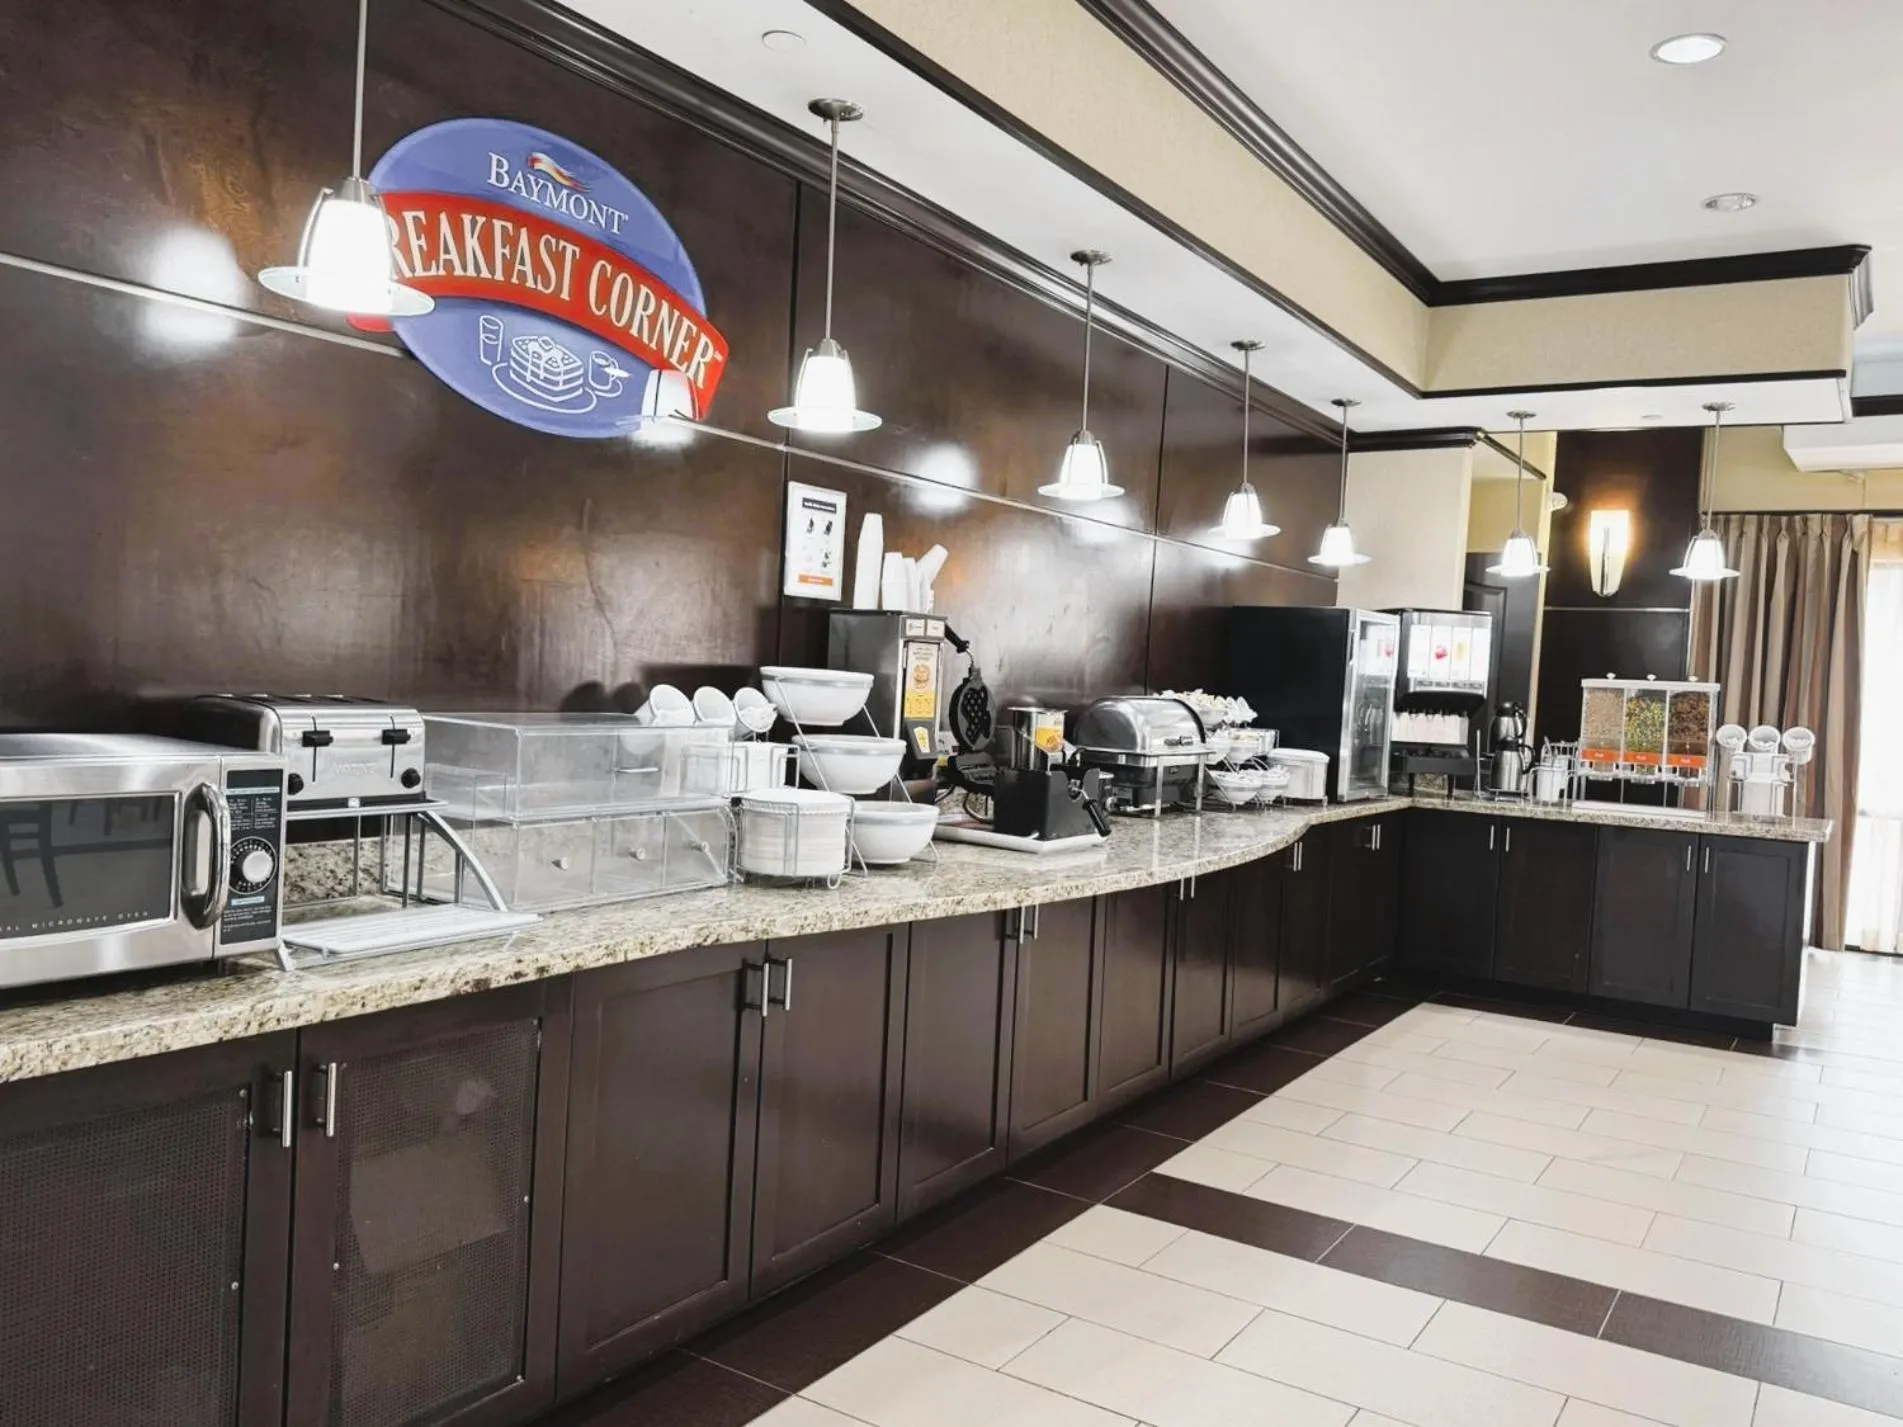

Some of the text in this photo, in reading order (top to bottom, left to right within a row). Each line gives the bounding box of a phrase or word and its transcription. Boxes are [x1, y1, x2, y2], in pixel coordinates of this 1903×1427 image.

[487, 151, 626, 235] BAYMONT
[385, 210, 714, 390] REAKFAST CORNER
